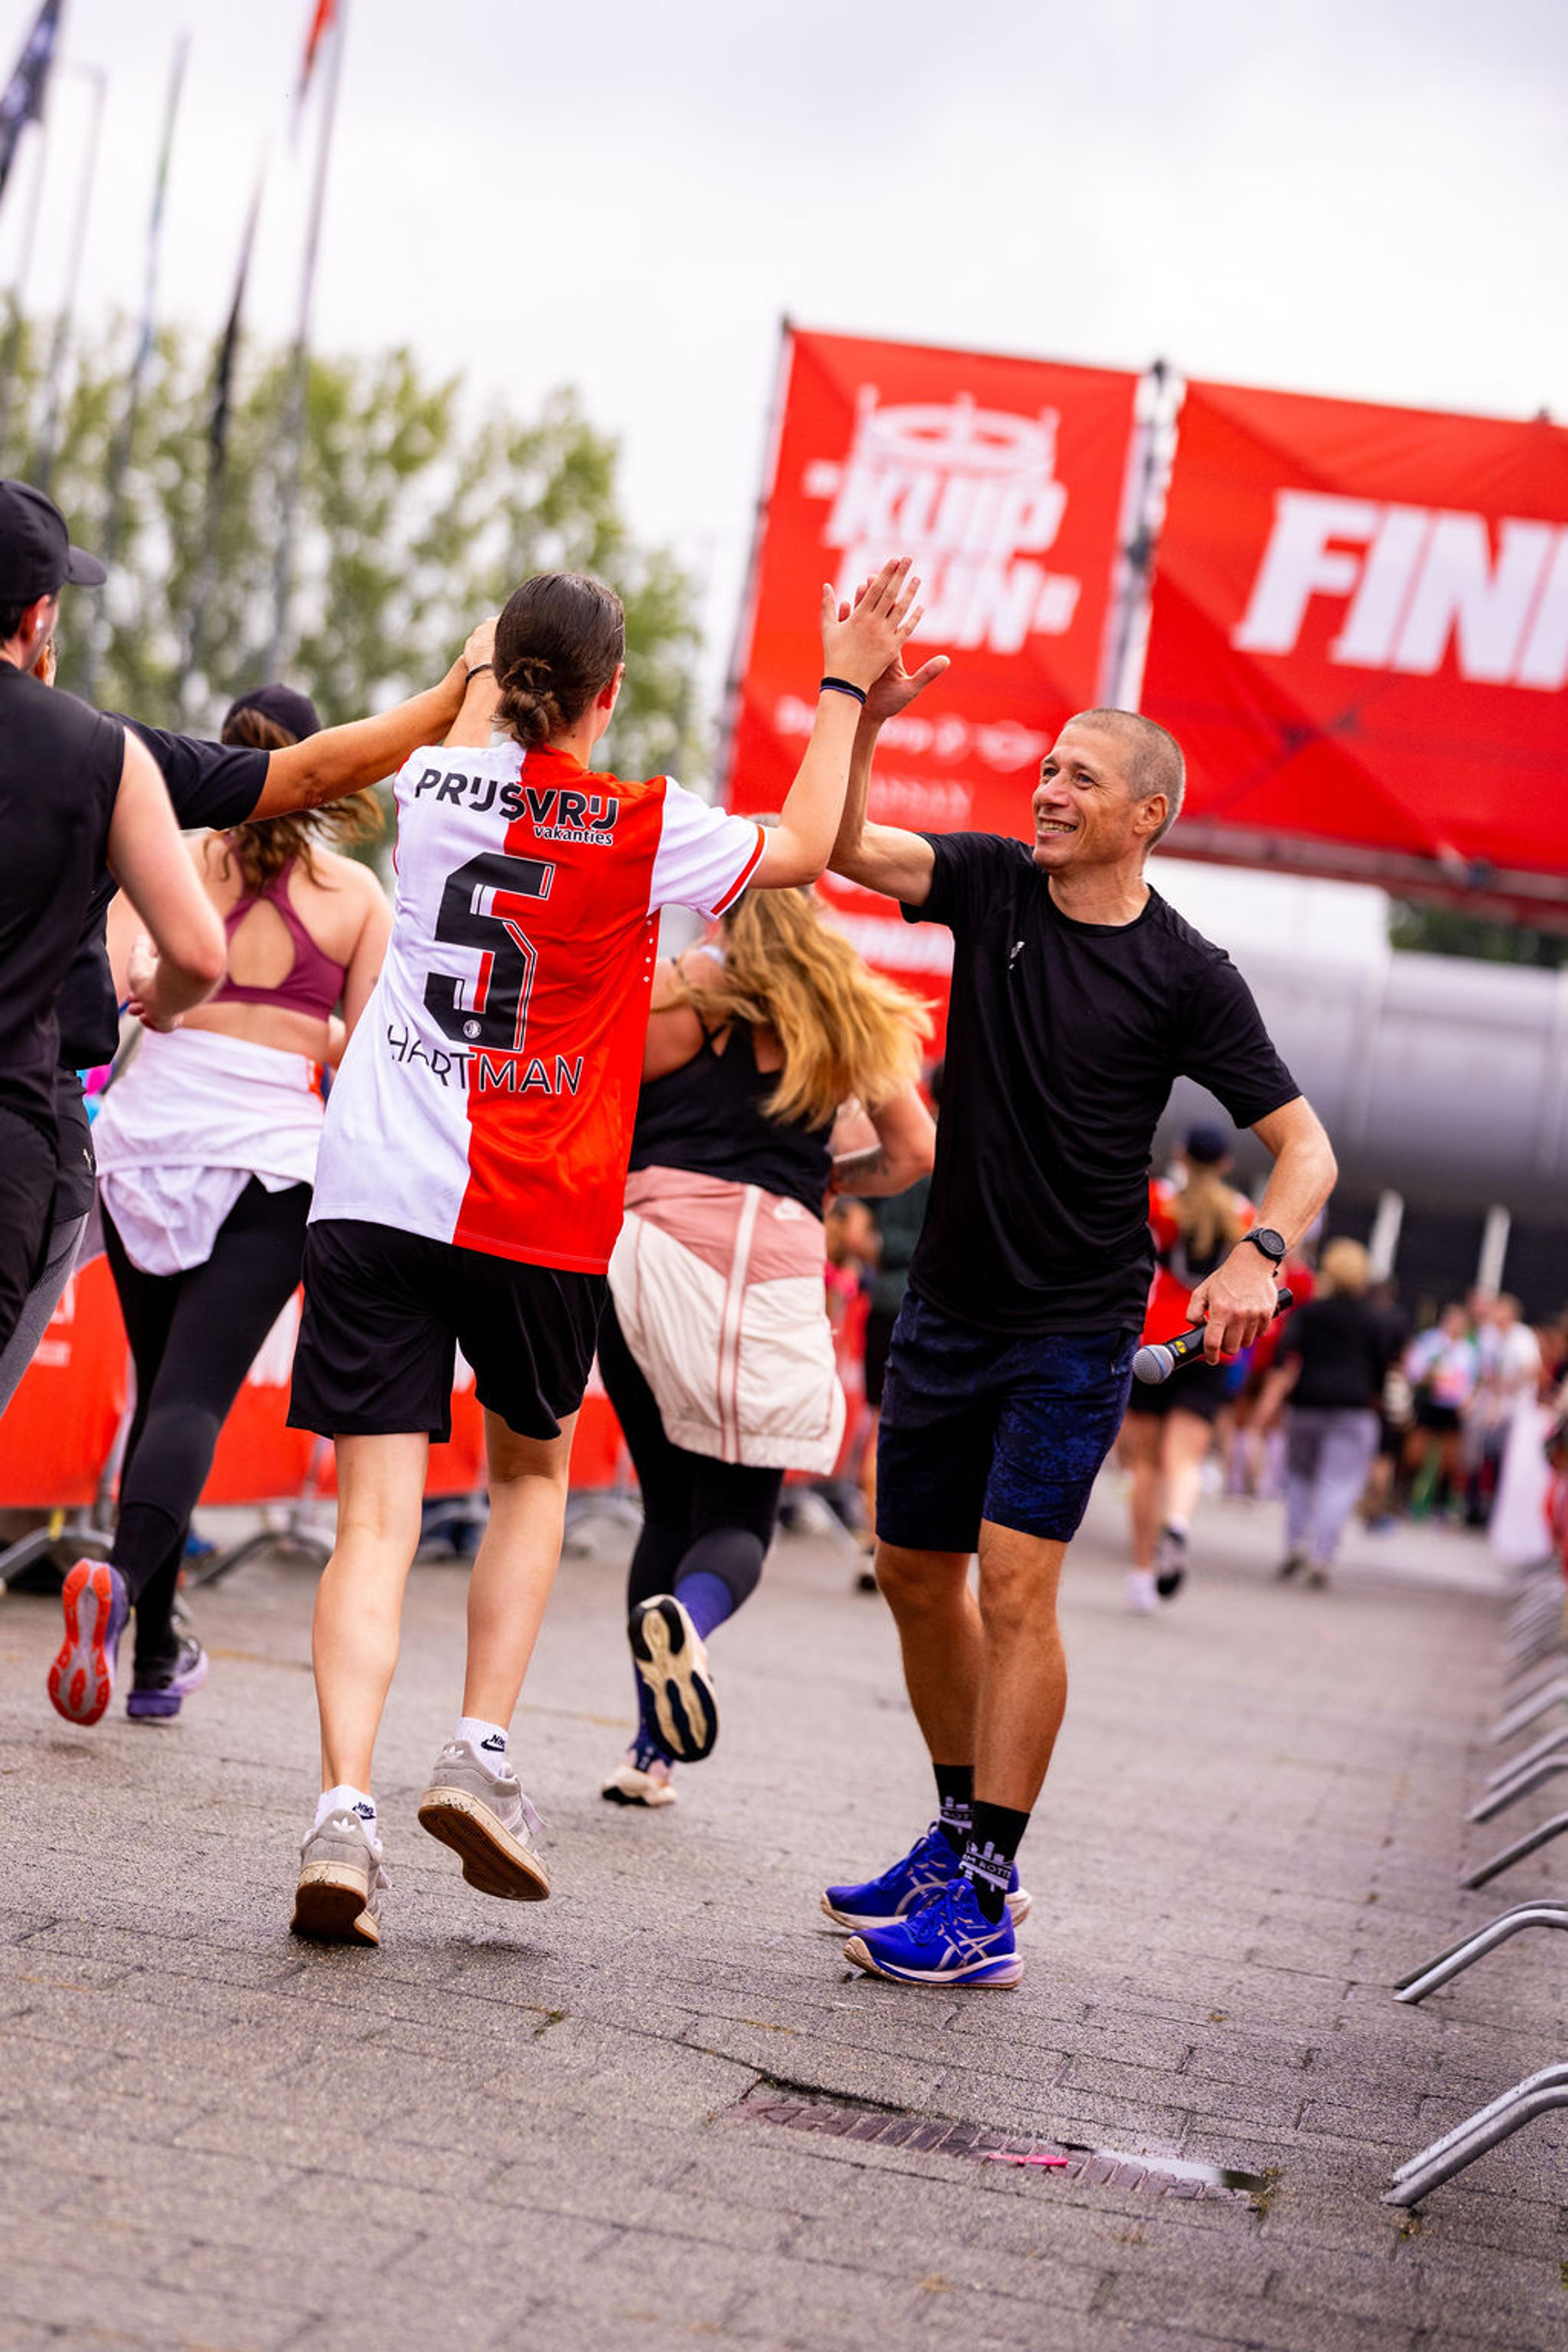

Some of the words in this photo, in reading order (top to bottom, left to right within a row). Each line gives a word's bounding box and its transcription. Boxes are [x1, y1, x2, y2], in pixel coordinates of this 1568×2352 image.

[823, 458, 1068, 555] KUIP
[534, 825, 613, 846] vakanties
[424, 851, 556, 1054] 5
[387, 1024, 584, 1095] HARTMAN
